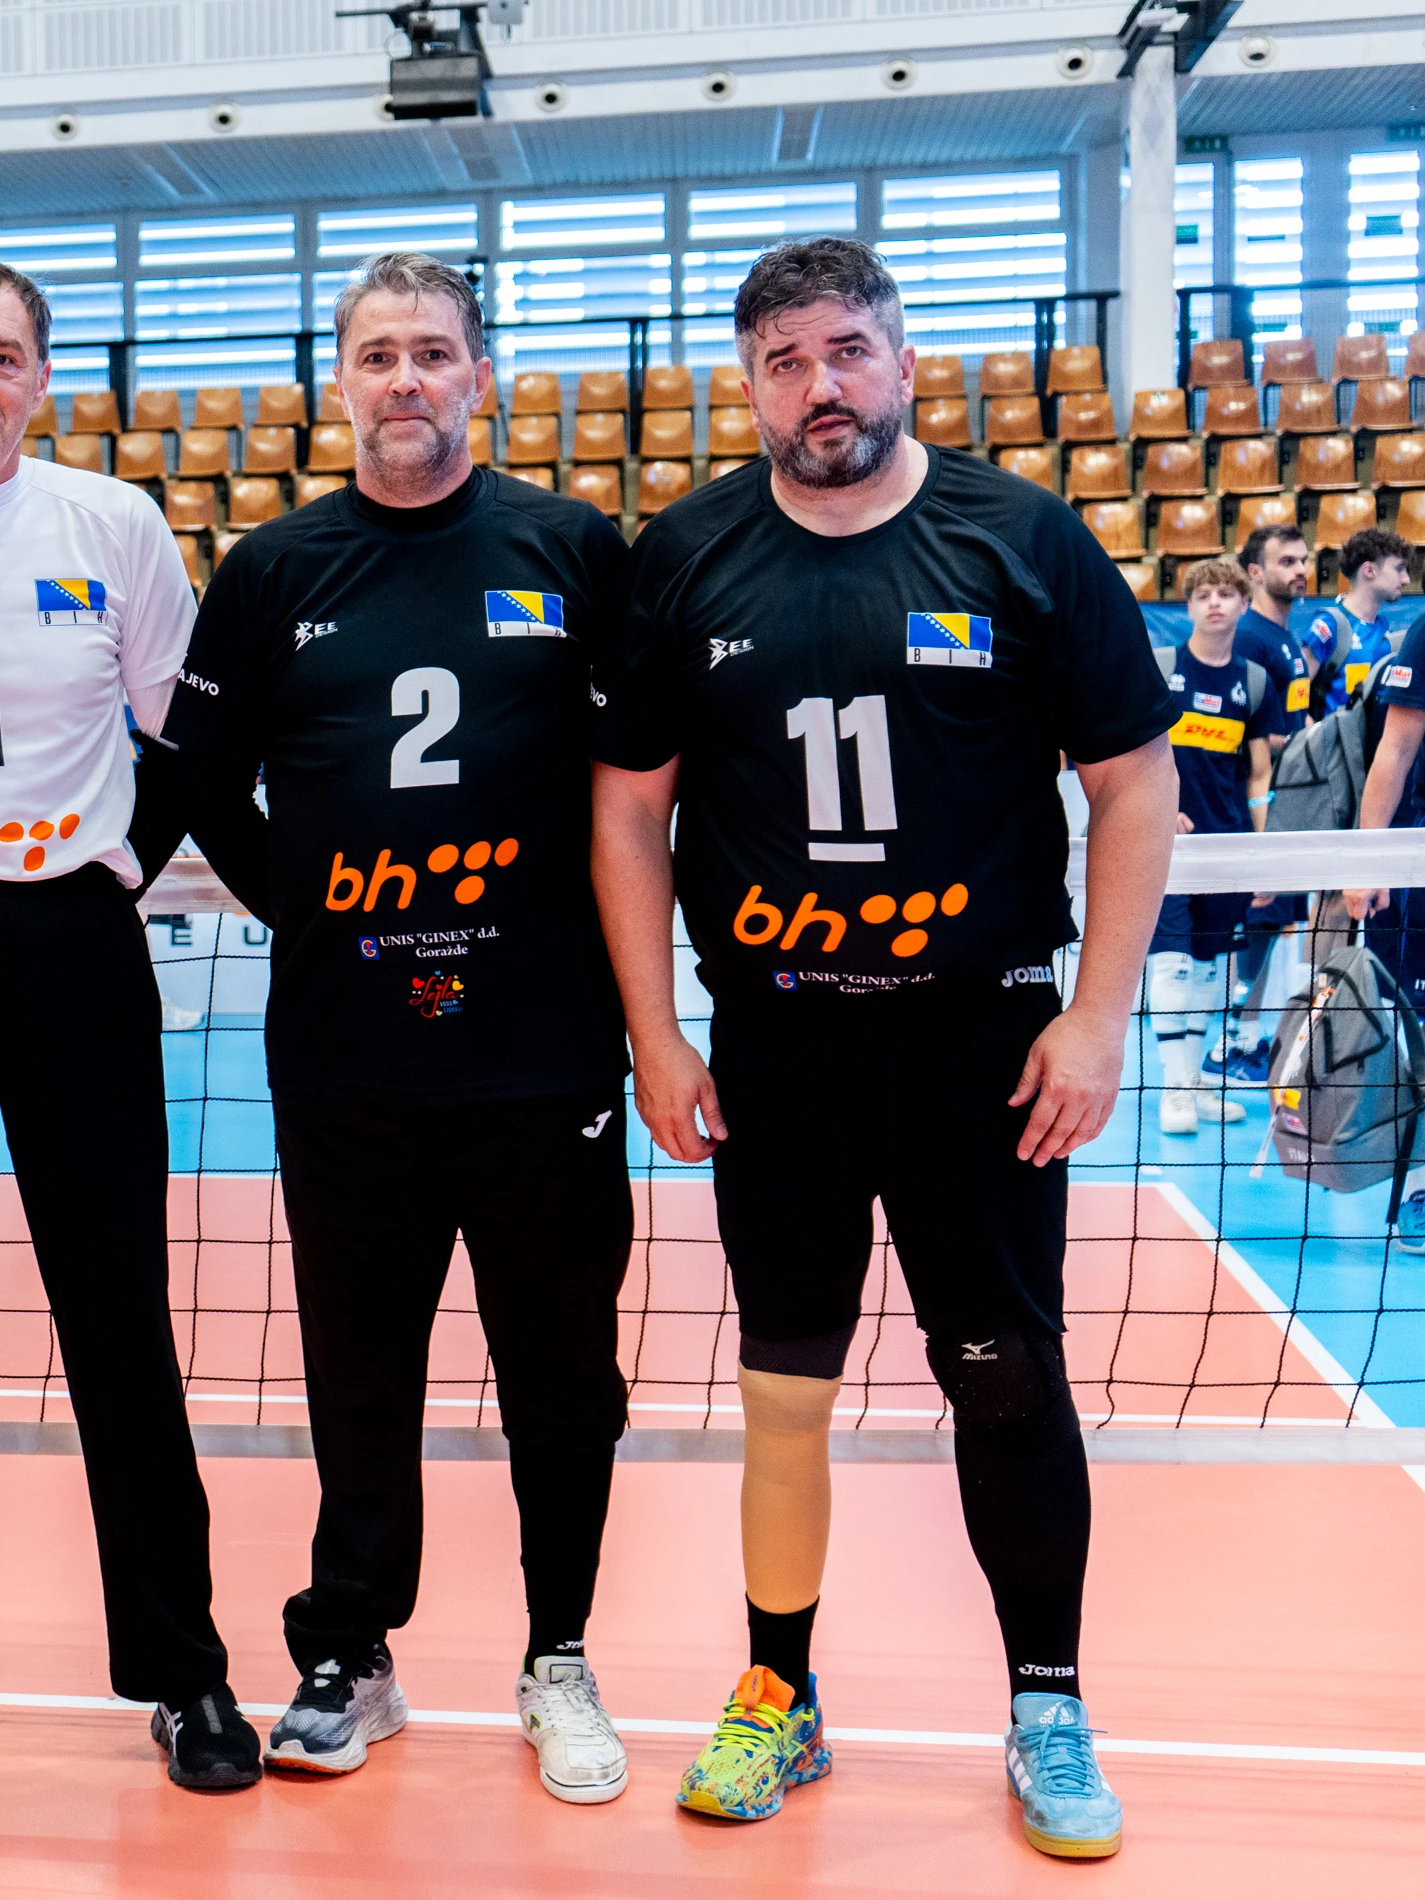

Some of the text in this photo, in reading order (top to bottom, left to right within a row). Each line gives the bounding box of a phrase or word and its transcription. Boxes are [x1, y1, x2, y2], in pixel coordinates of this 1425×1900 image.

[389, 666, 460, 789] 2
[786, 694, 898, 831] 11
[325, 848, 417, 912] bh
[733, 884, 847, 953] bh
[379, 933, 415, 947] UNIS
[417, 928, 475, 944] "GINEX"
[477, 926, 501, 939] d.d.
[415, 944, 469, 958] Goražde
[798, 971, 840, 983] UNIS
[842, 973, 909, 986] "GINEX"
[1001, 965, 1054, 988] Joma
[1018, 1663, 1075, 1677] Joma
